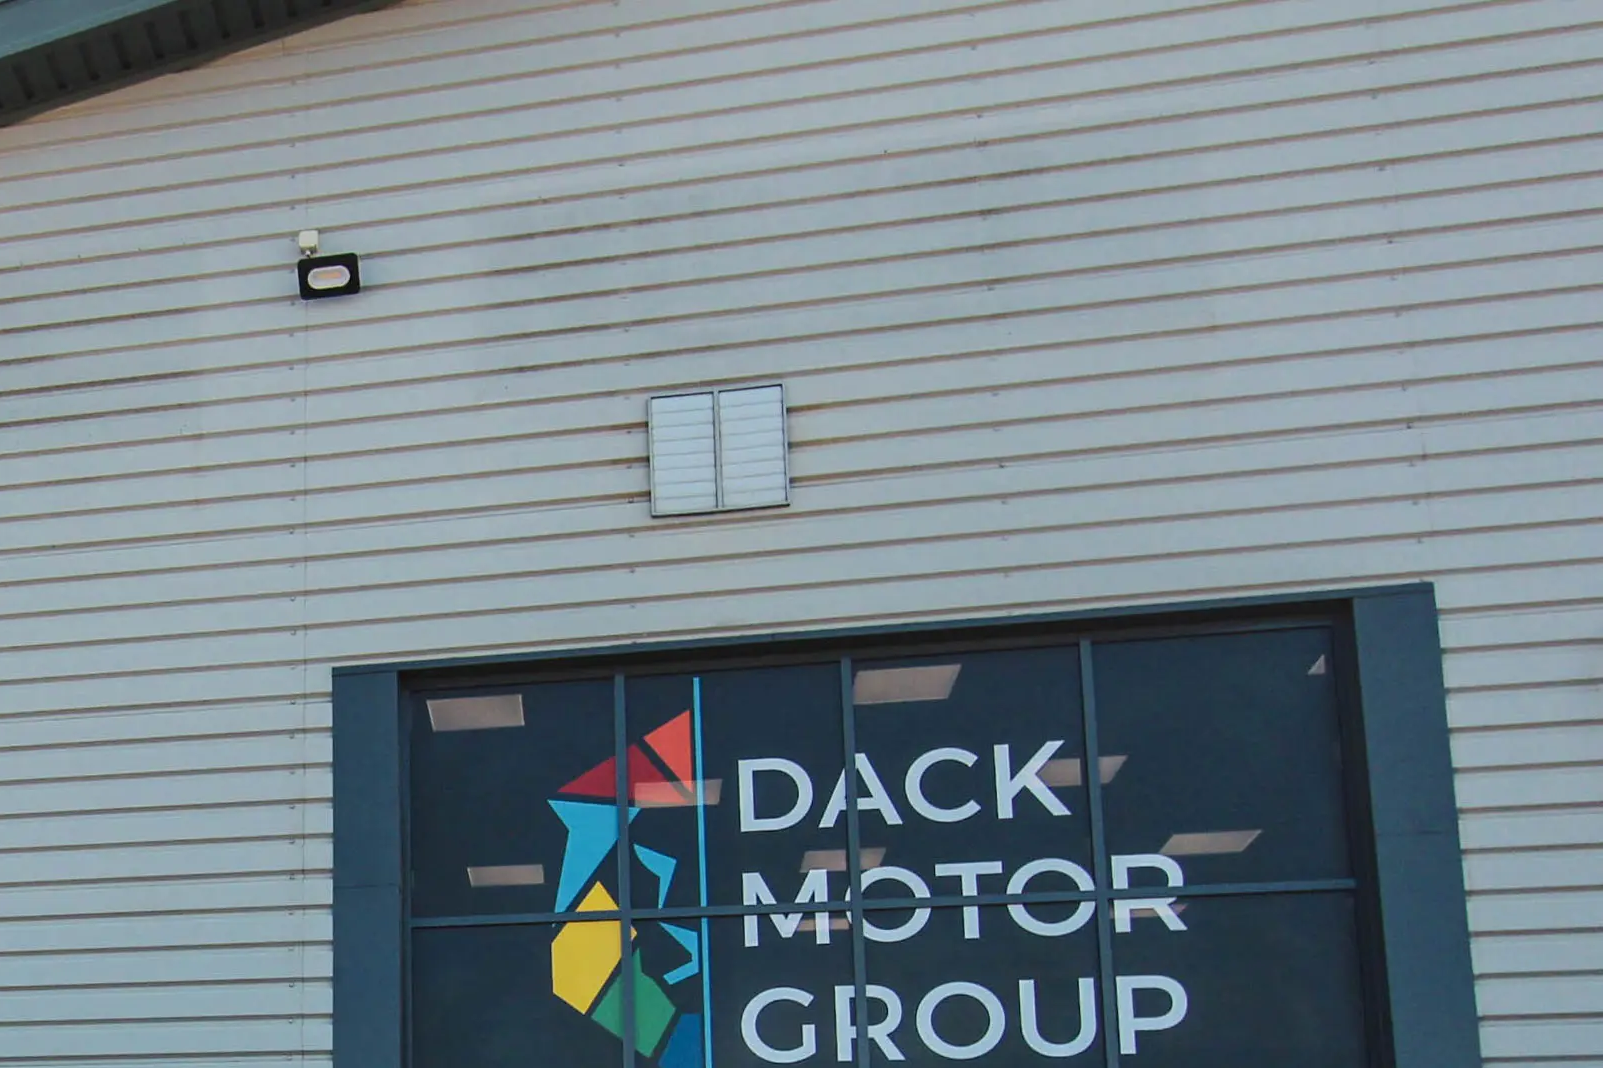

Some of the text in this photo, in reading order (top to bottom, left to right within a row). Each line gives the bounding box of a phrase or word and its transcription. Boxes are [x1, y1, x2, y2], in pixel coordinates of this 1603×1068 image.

[738, 740, 1071, 832] DACK
[742, 854, 1188, 947] MOTOR
[741, 975, 1188, 1063] GROUP
